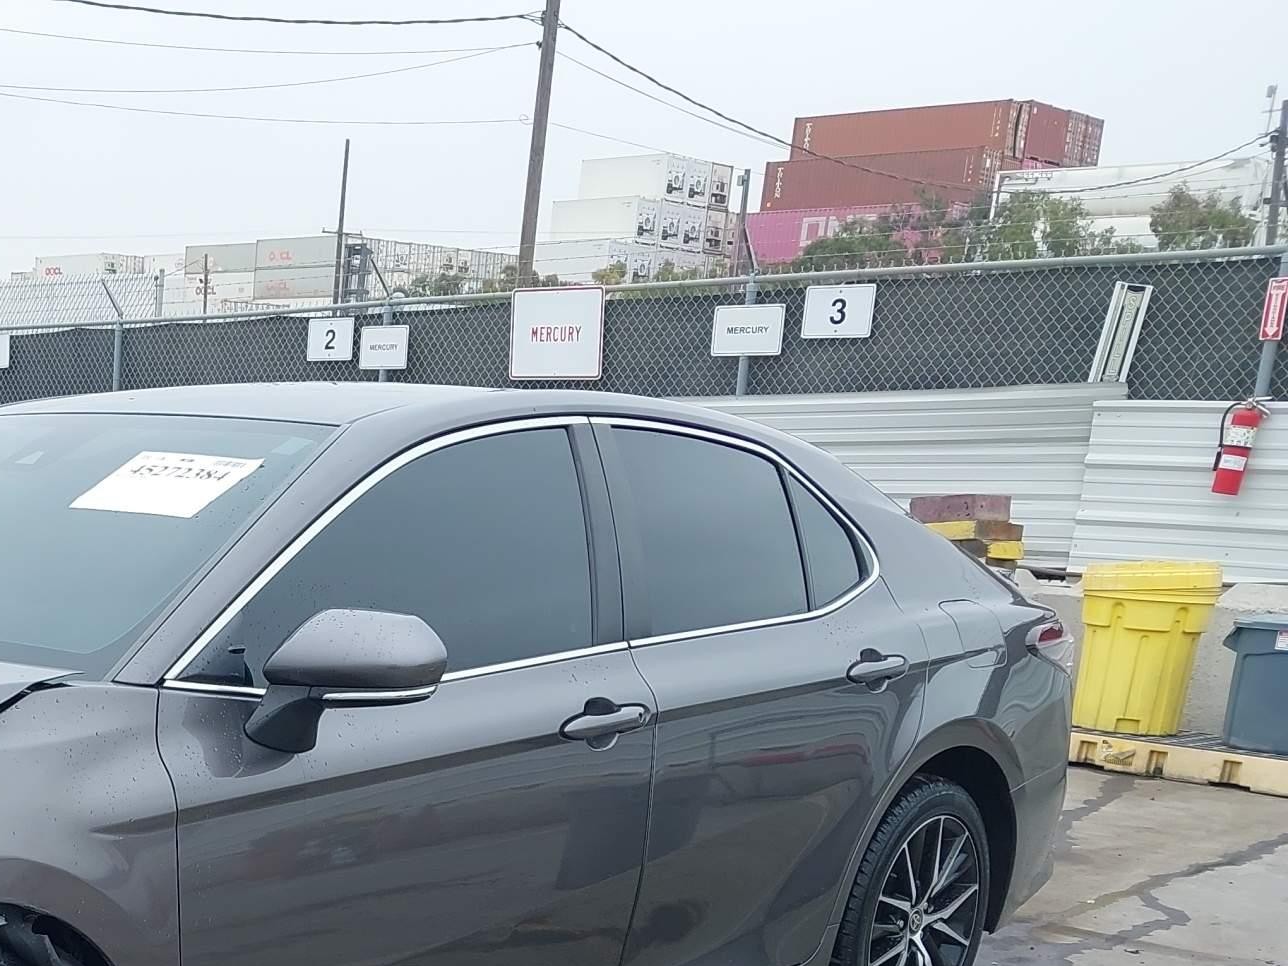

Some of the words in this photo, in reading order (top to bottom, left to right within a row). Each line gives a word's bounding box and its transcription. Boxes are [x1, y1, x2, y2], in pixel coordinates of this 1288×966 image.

[829, 298, 847, 325] 3
[531, 325, 581, 342] MERCURY
[726, 325, 769, 335] MERCURY
[324, 329, 336, 350] 2
[131, 465, 231, 481] 45272384
